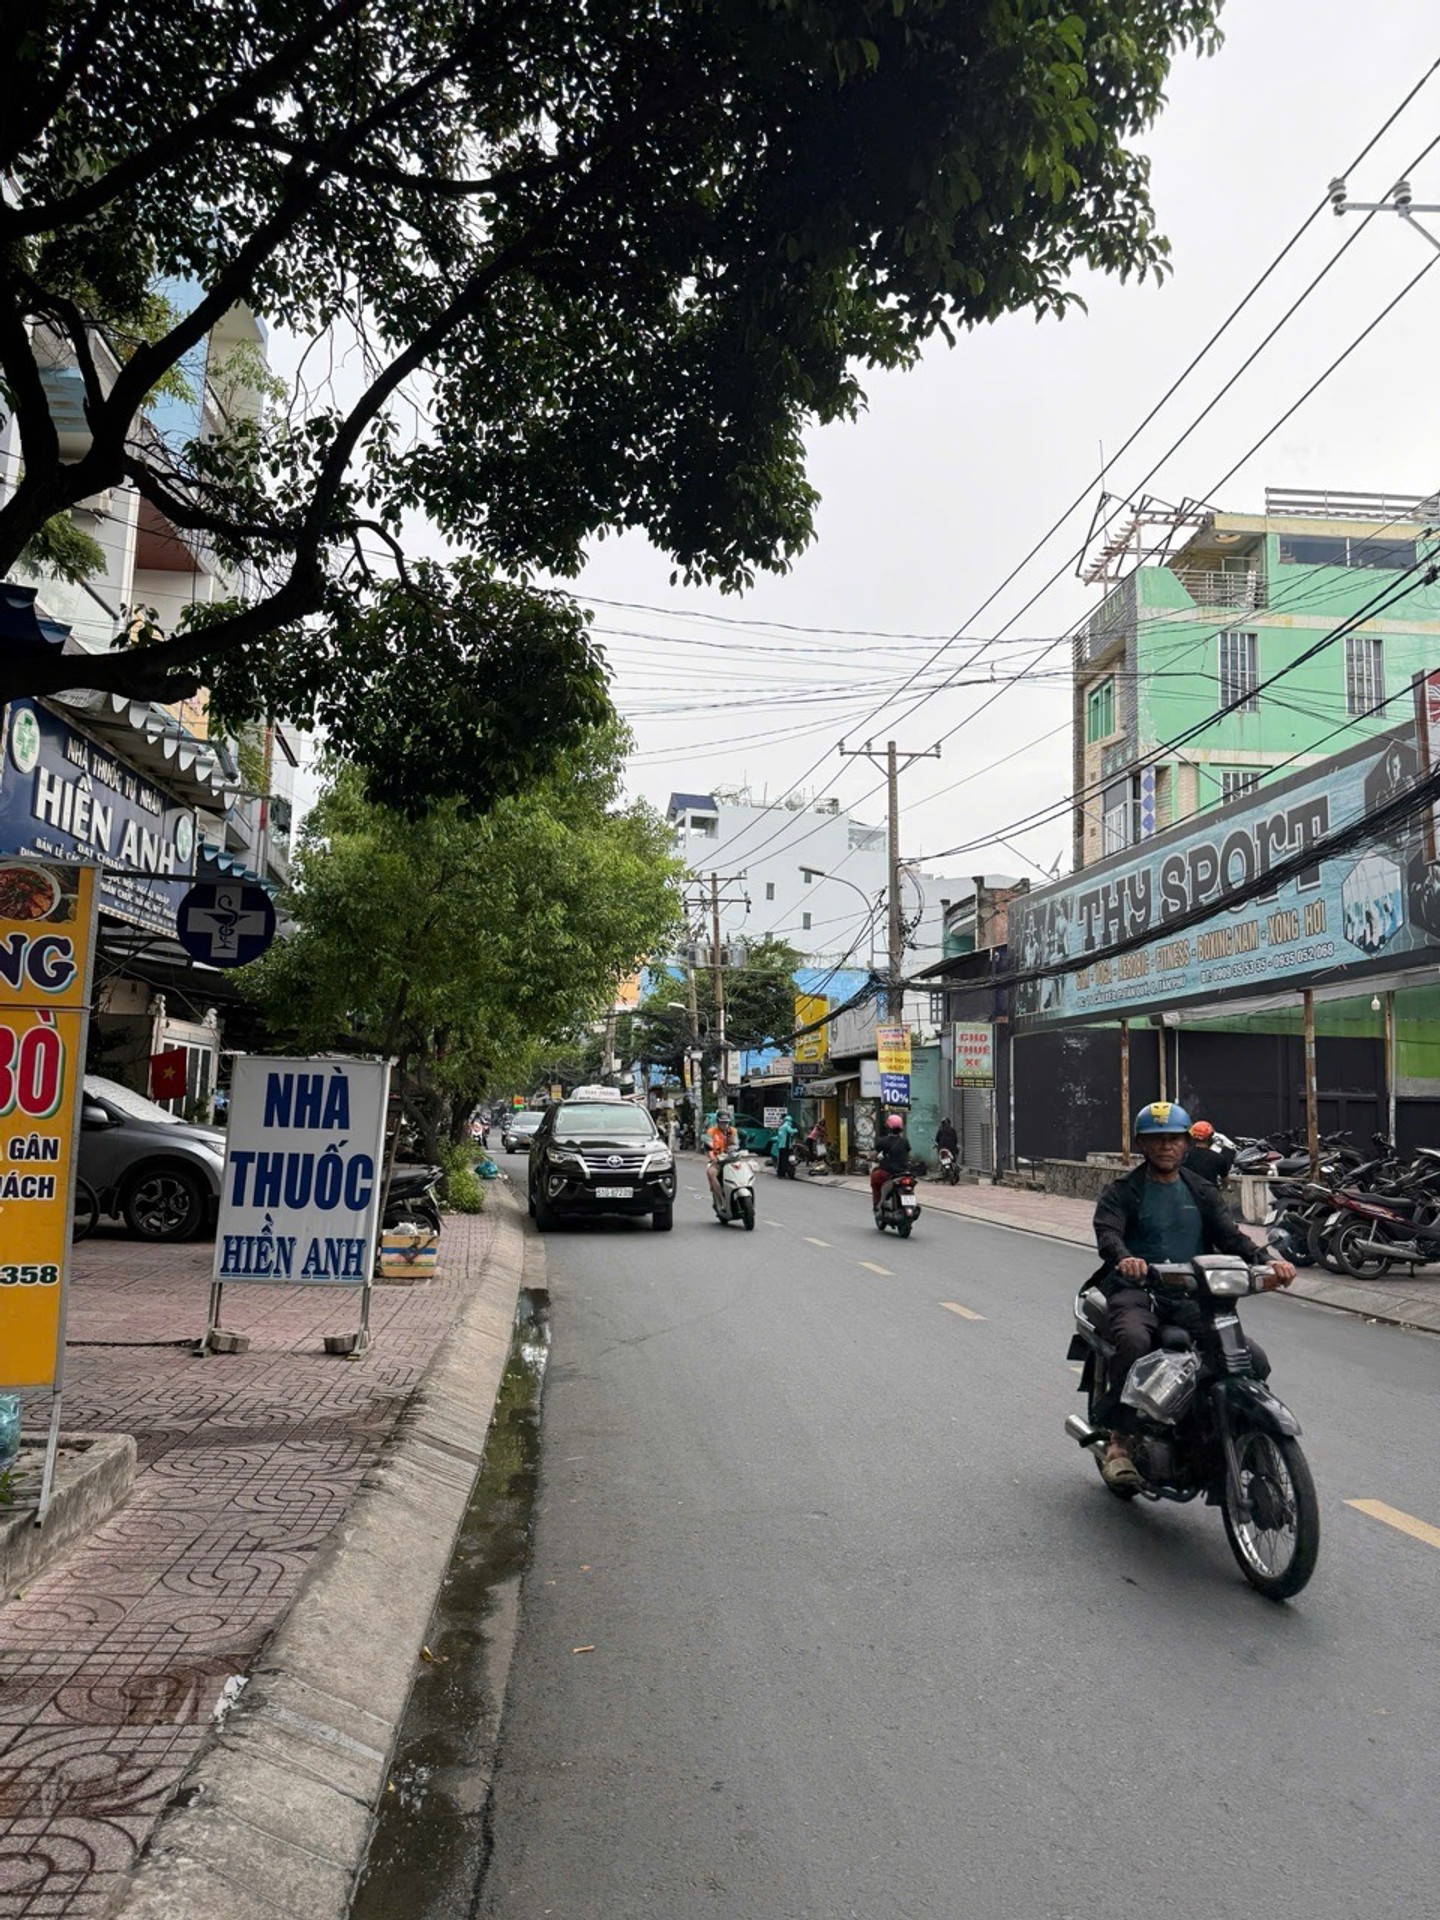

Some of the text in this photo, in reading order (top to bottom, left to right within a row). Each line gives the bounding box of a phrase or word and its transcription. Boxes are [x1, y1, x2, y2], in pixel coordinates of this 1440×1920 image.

[67, 738, 89, 772] NHÀ
[36, 766, 175, 883] HIỀN ANH
[1155, 939, 1191, 973] FITNESS
[1267, 905, 1299, 946] XÔNG
[263, 1066, 350, 1130] NHÀ
[883, 1089, 909, 1103] 10%
[8, 1133, 60, 1161] GÂN
[229, 1140, 374, 1211] THUỐC
[0, 1172, 55, 1199] ÁCH
[220, 1212, 367, 1280] HIỀN ANH
